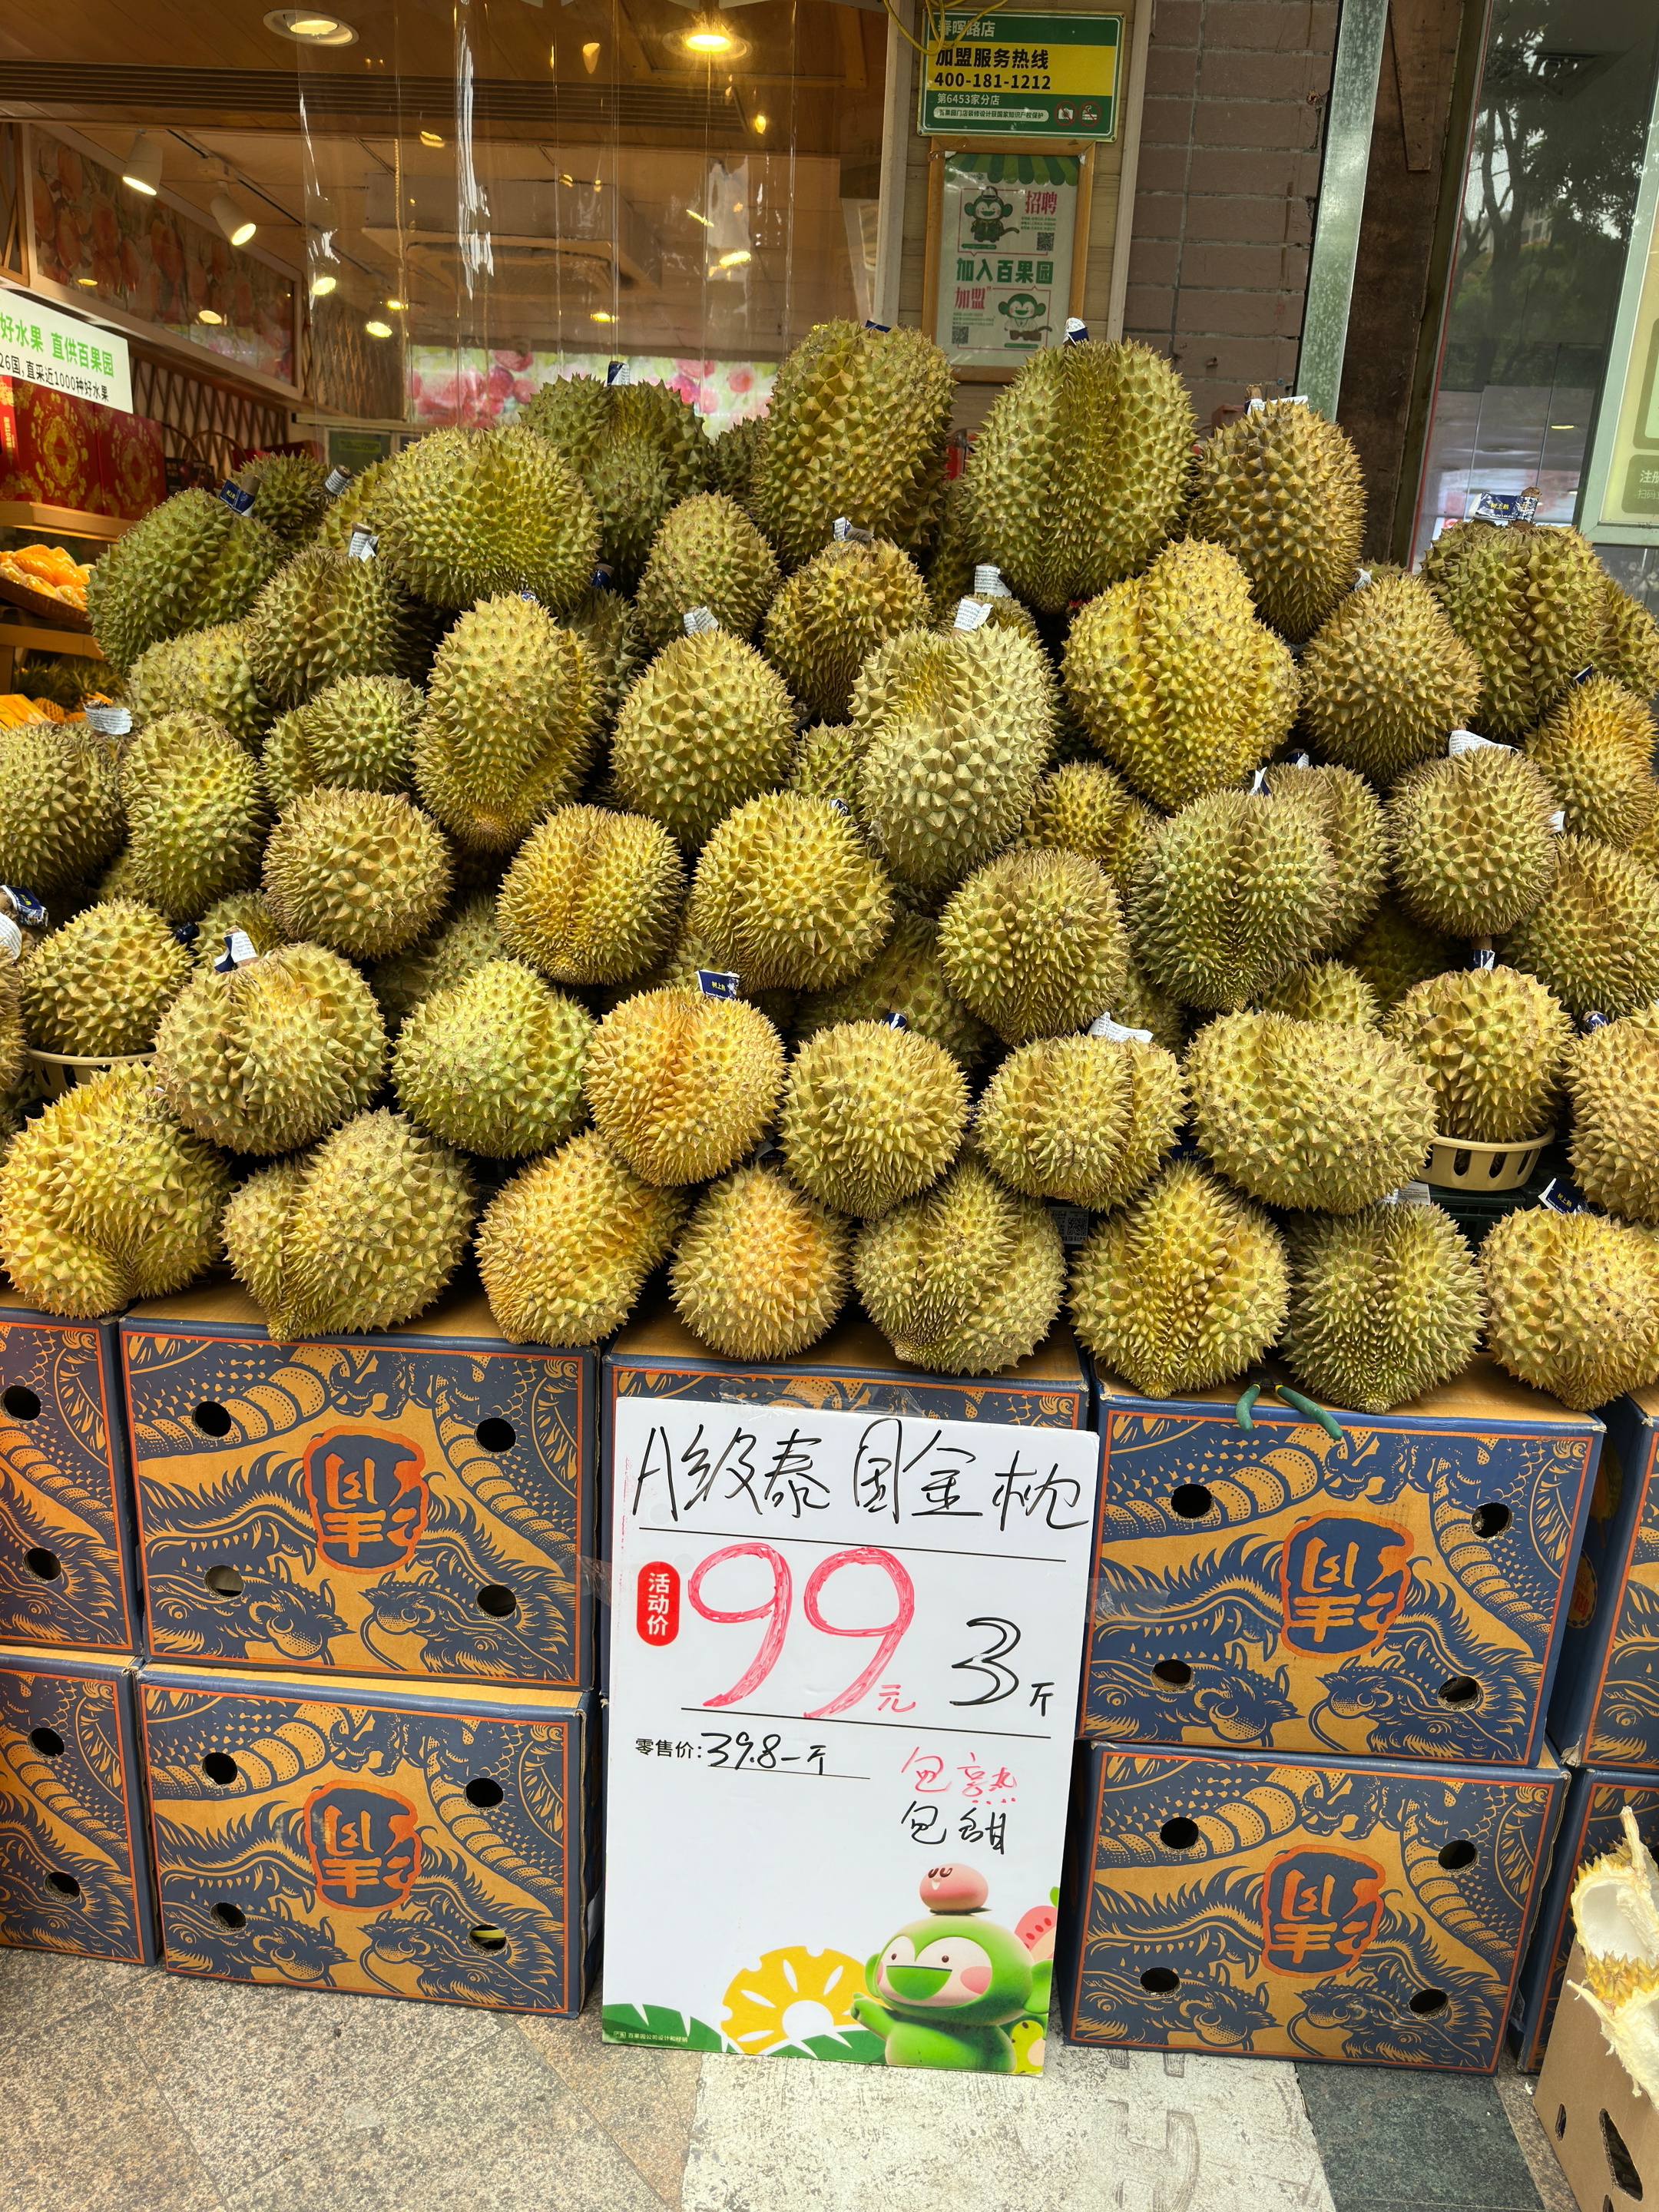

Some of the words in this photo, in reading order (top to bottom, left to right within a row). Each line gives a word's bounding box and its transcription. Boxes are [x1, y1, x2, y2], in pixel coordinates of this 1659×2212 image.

[935, 48, 1049, 70] 加盟服务热线
[934, 72, 1051, 90] 400-181-1212
[937, 93, 1000, 105] 第6453家分店
[1025, 190, 1058, 214] 招聘
[956, 257, 1054, 284] 加入百果园
[51, 332, 114, 377] 直供百果园
[647, 1572, 671, 1637] 活动价
